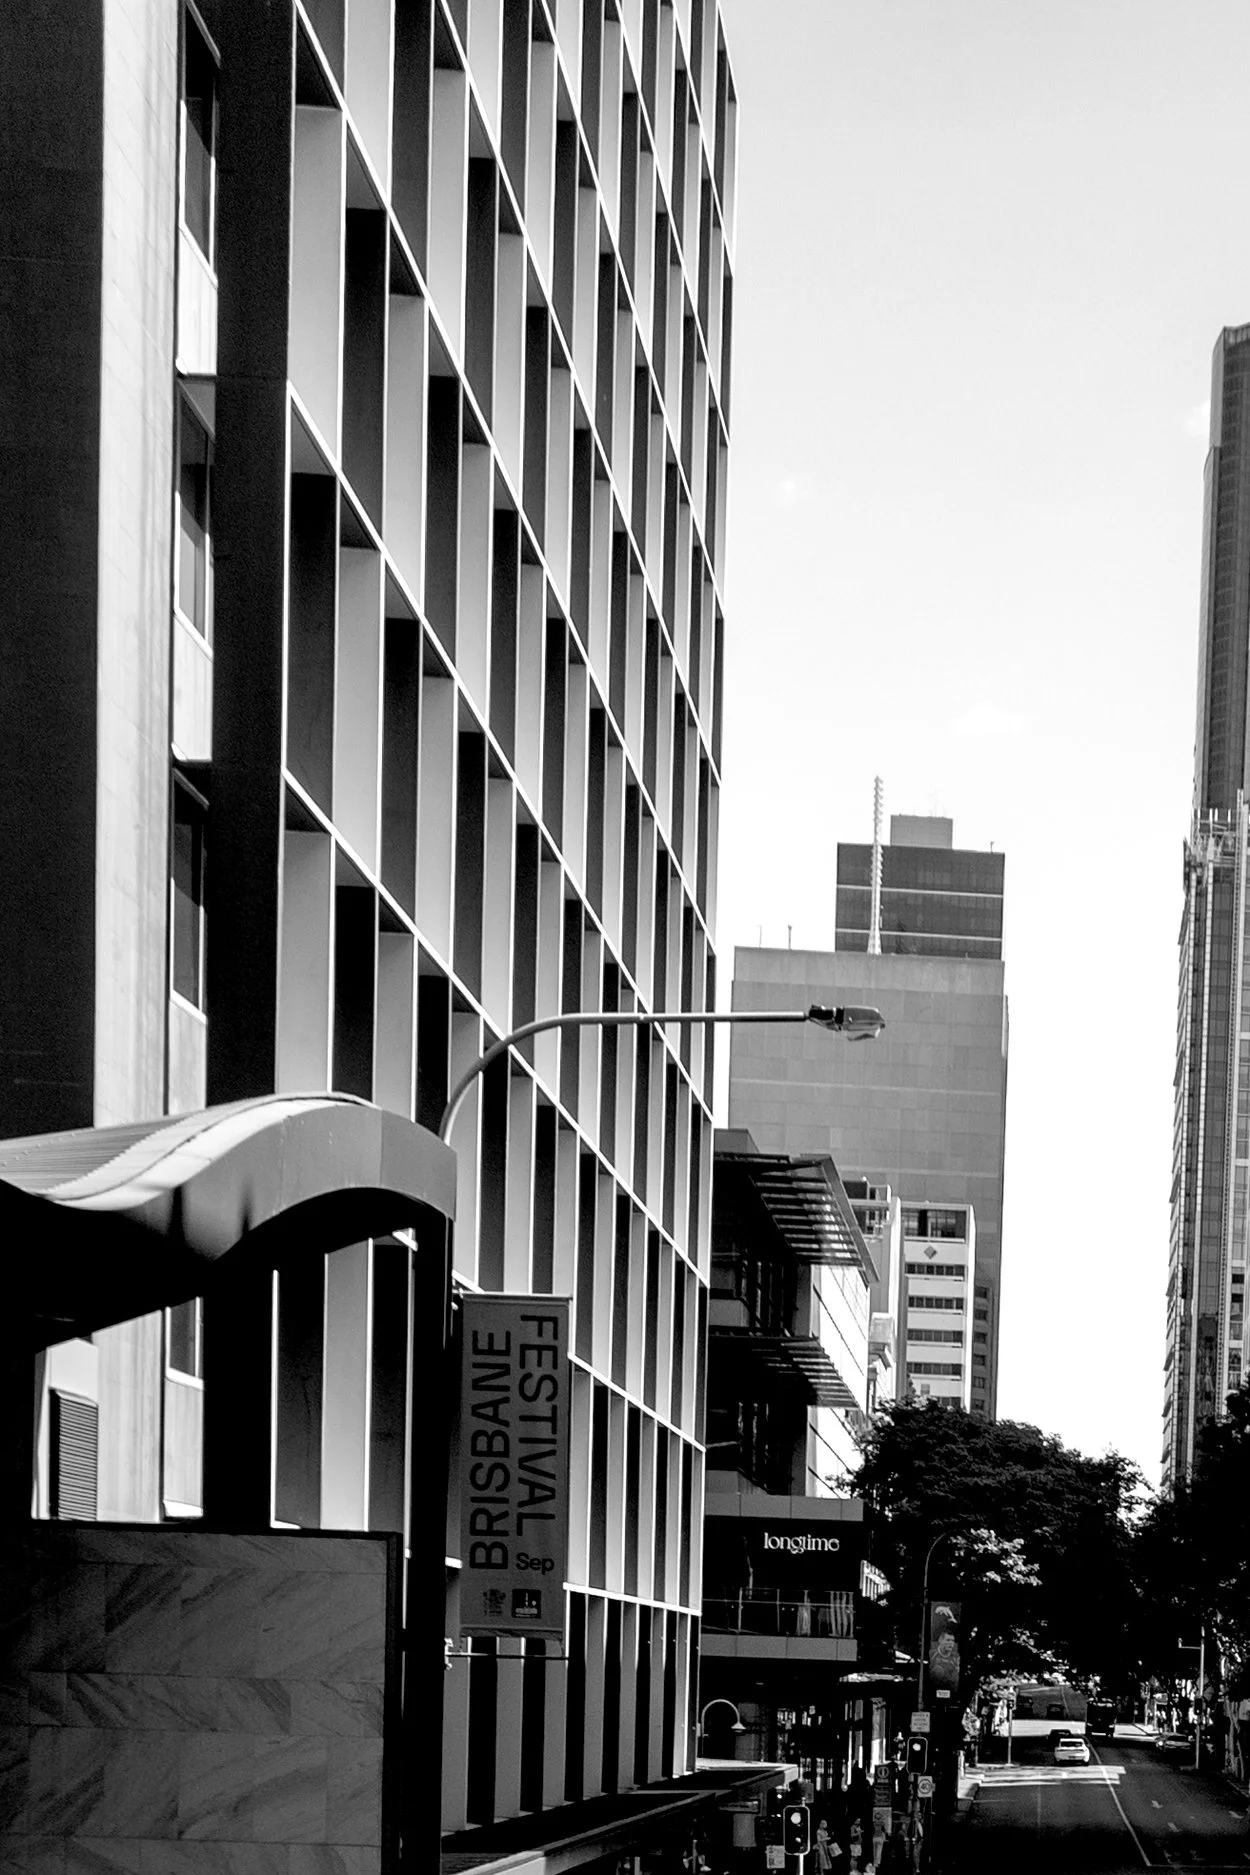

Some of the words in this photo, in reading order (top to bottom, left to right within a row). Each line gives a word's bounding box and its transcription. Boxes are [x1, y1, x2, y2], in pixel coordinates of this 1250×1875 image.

[469, 1330, 511, 1570] BRISBANE
[516, 1314, 559, 1536] FESTIVAL
[515, 1552, 555, 1575] Sep
[764, 1532, 840, 1554] longtime
